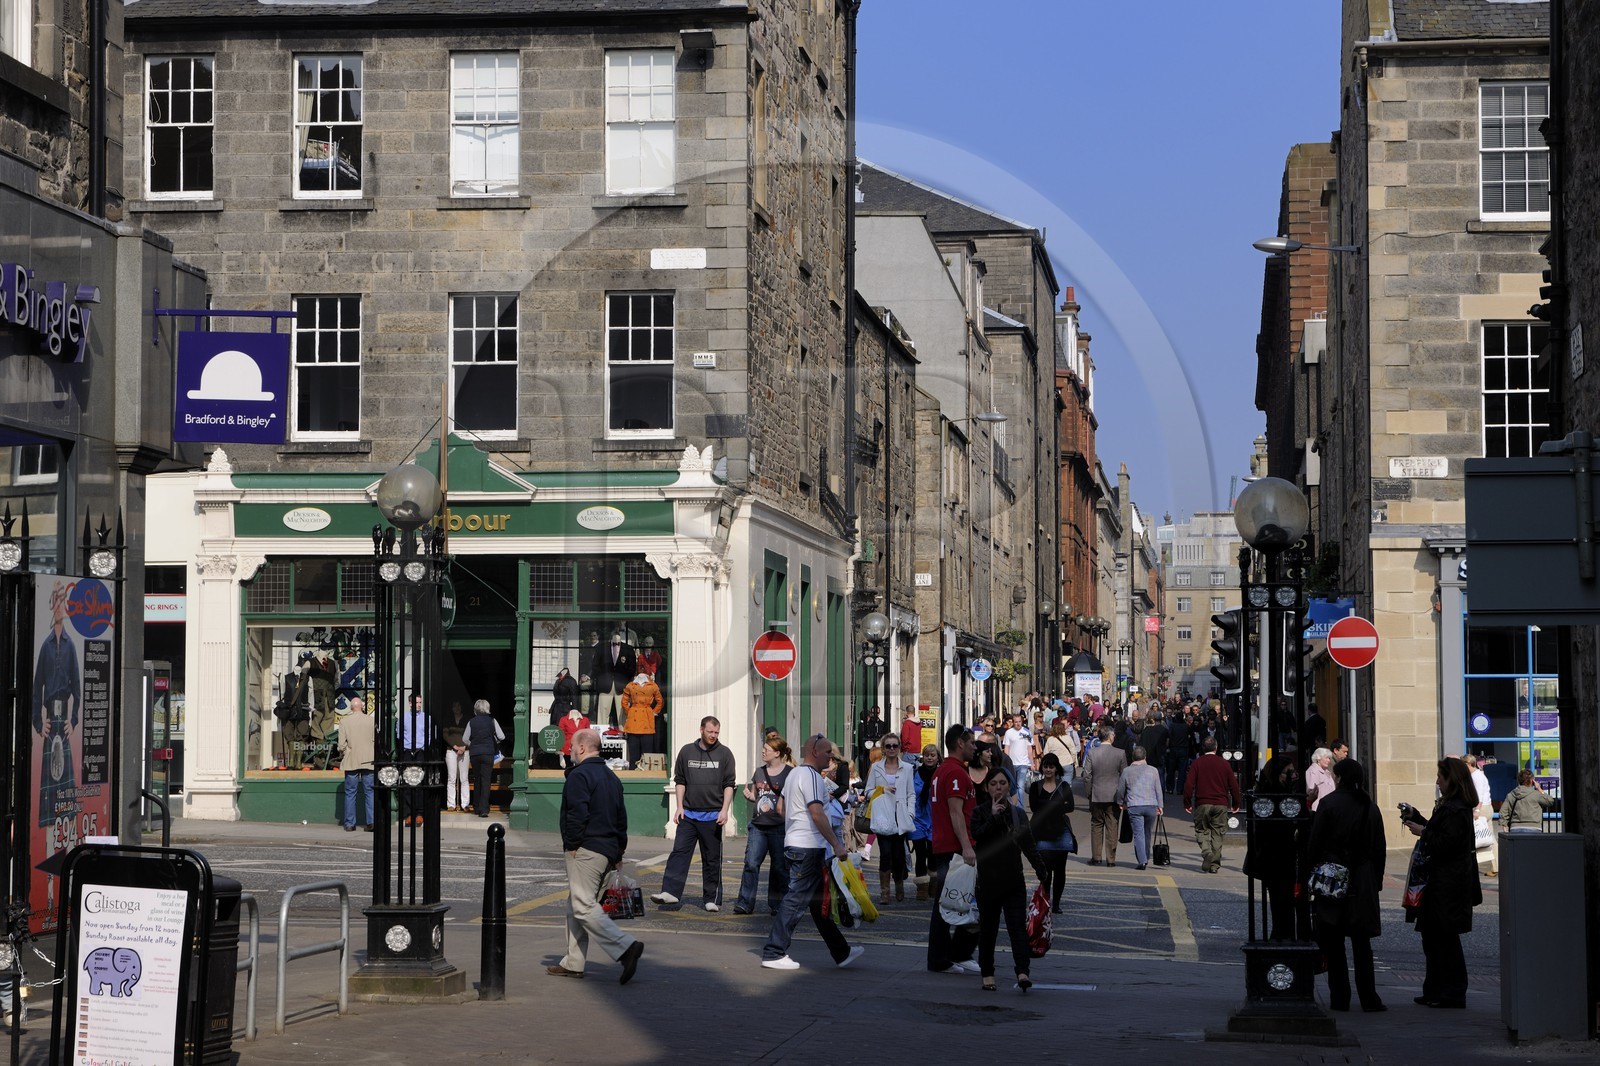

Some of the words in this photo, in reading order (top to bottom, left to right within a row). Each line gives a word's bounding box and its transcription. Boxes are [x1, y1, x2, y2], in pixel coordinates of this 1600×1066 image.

[15, 264, 92, 363] Bingley
[185, 414, 225, 424] Bradford
[227, 416, 235, 425] &
[237, 415, 270, 428] Bingley
[1402, 468, 1435, 476] STREET
[470, 597, 480, 606] 21
[293, 741, 333, 751] Barbour
[546, 737, 556, 745] off
[952, 779, 959, 790] 1
[84, 891, 140, 914] Calistoga
[116, 922, 138, 932] Sunday
[139, 924, 154, 932] from
[86, 932, 107, 941] Sunday
